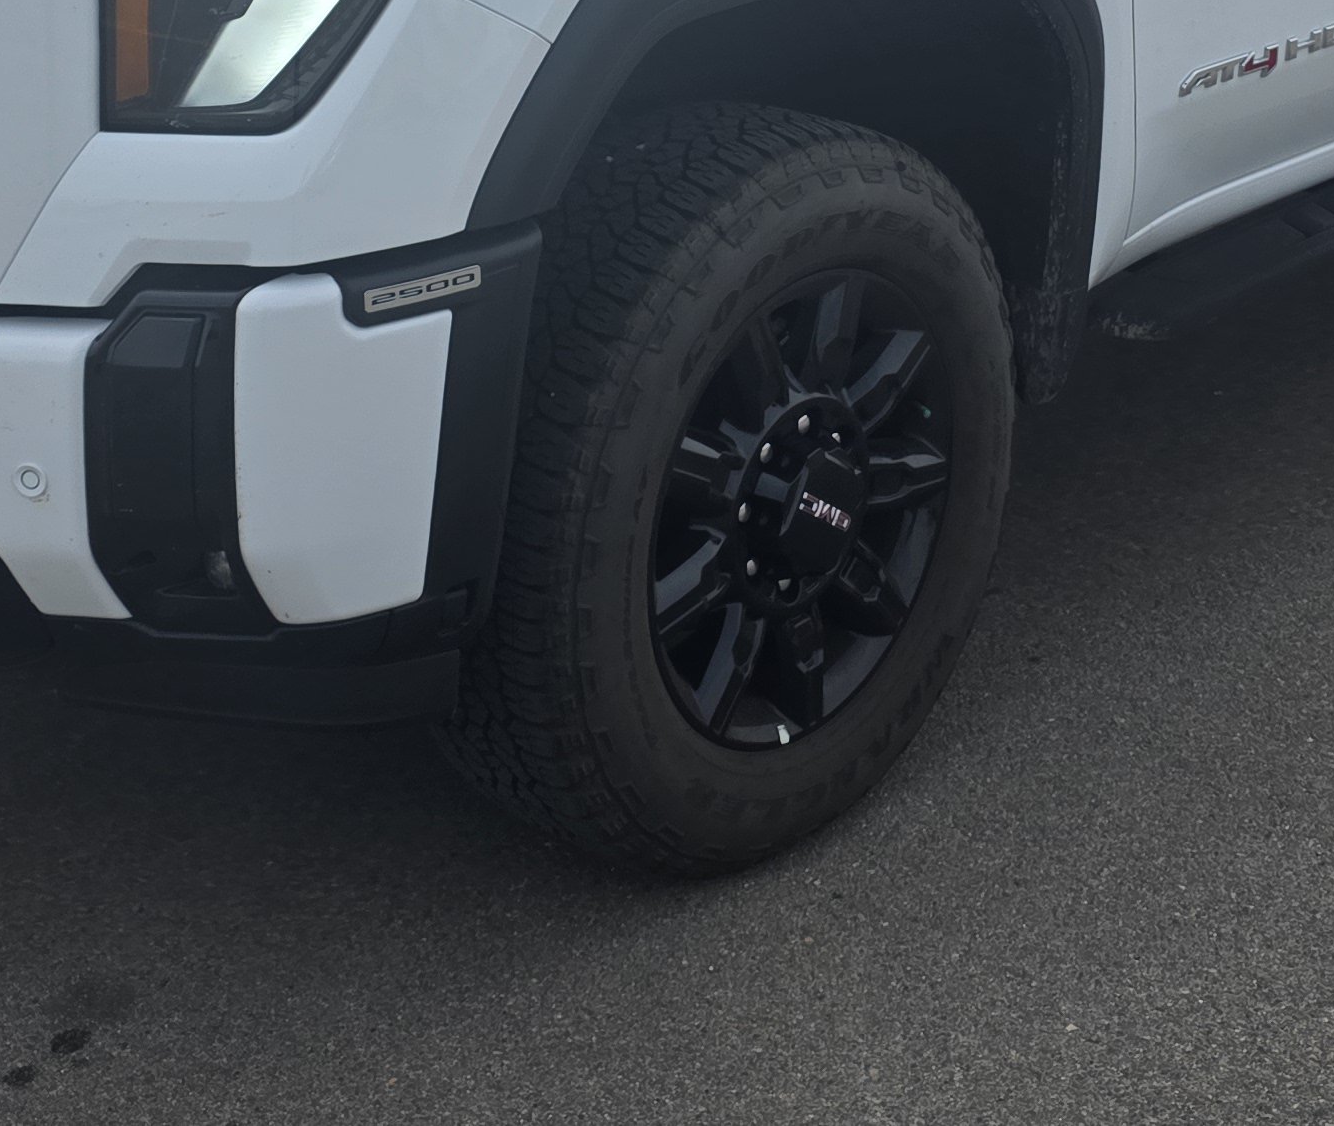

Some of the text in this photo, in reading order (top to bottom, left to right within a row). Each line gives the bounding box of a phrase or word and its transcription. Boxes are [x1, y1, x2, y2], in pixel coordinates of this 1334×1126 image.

[1178, 42, 1280, 97] AT4
[370, 273, 476, 306] 2500
[798, 491, 852, 532] GMC
